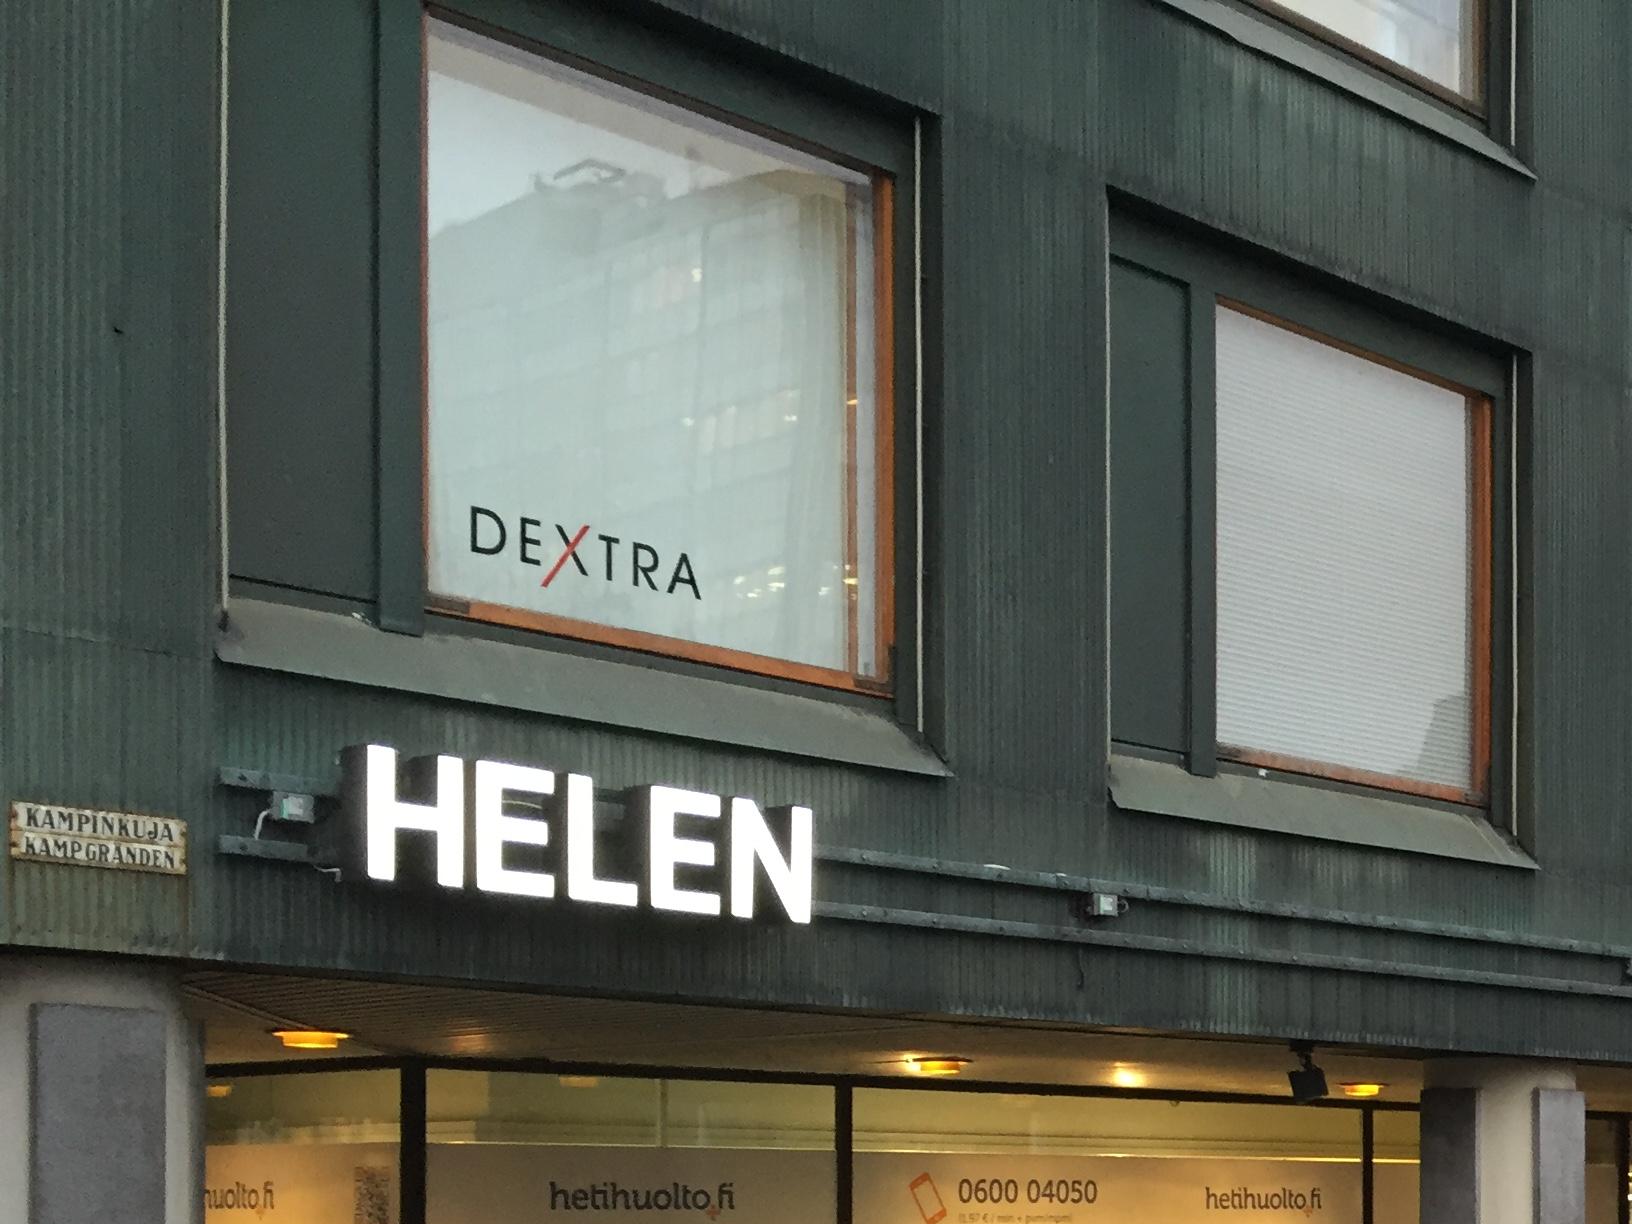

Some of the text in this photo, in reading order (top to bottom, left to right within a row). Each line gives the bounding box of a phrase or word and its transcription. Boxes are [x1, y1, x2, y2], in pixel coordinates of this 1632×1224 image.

[469, 505, 703, 600] DEXTRA
[26, 806, 175, 842] KAMPINKUJA
[366, 743, 813, 925] HELEN
[958, 1178, 1098, 1204] 0600 04050
